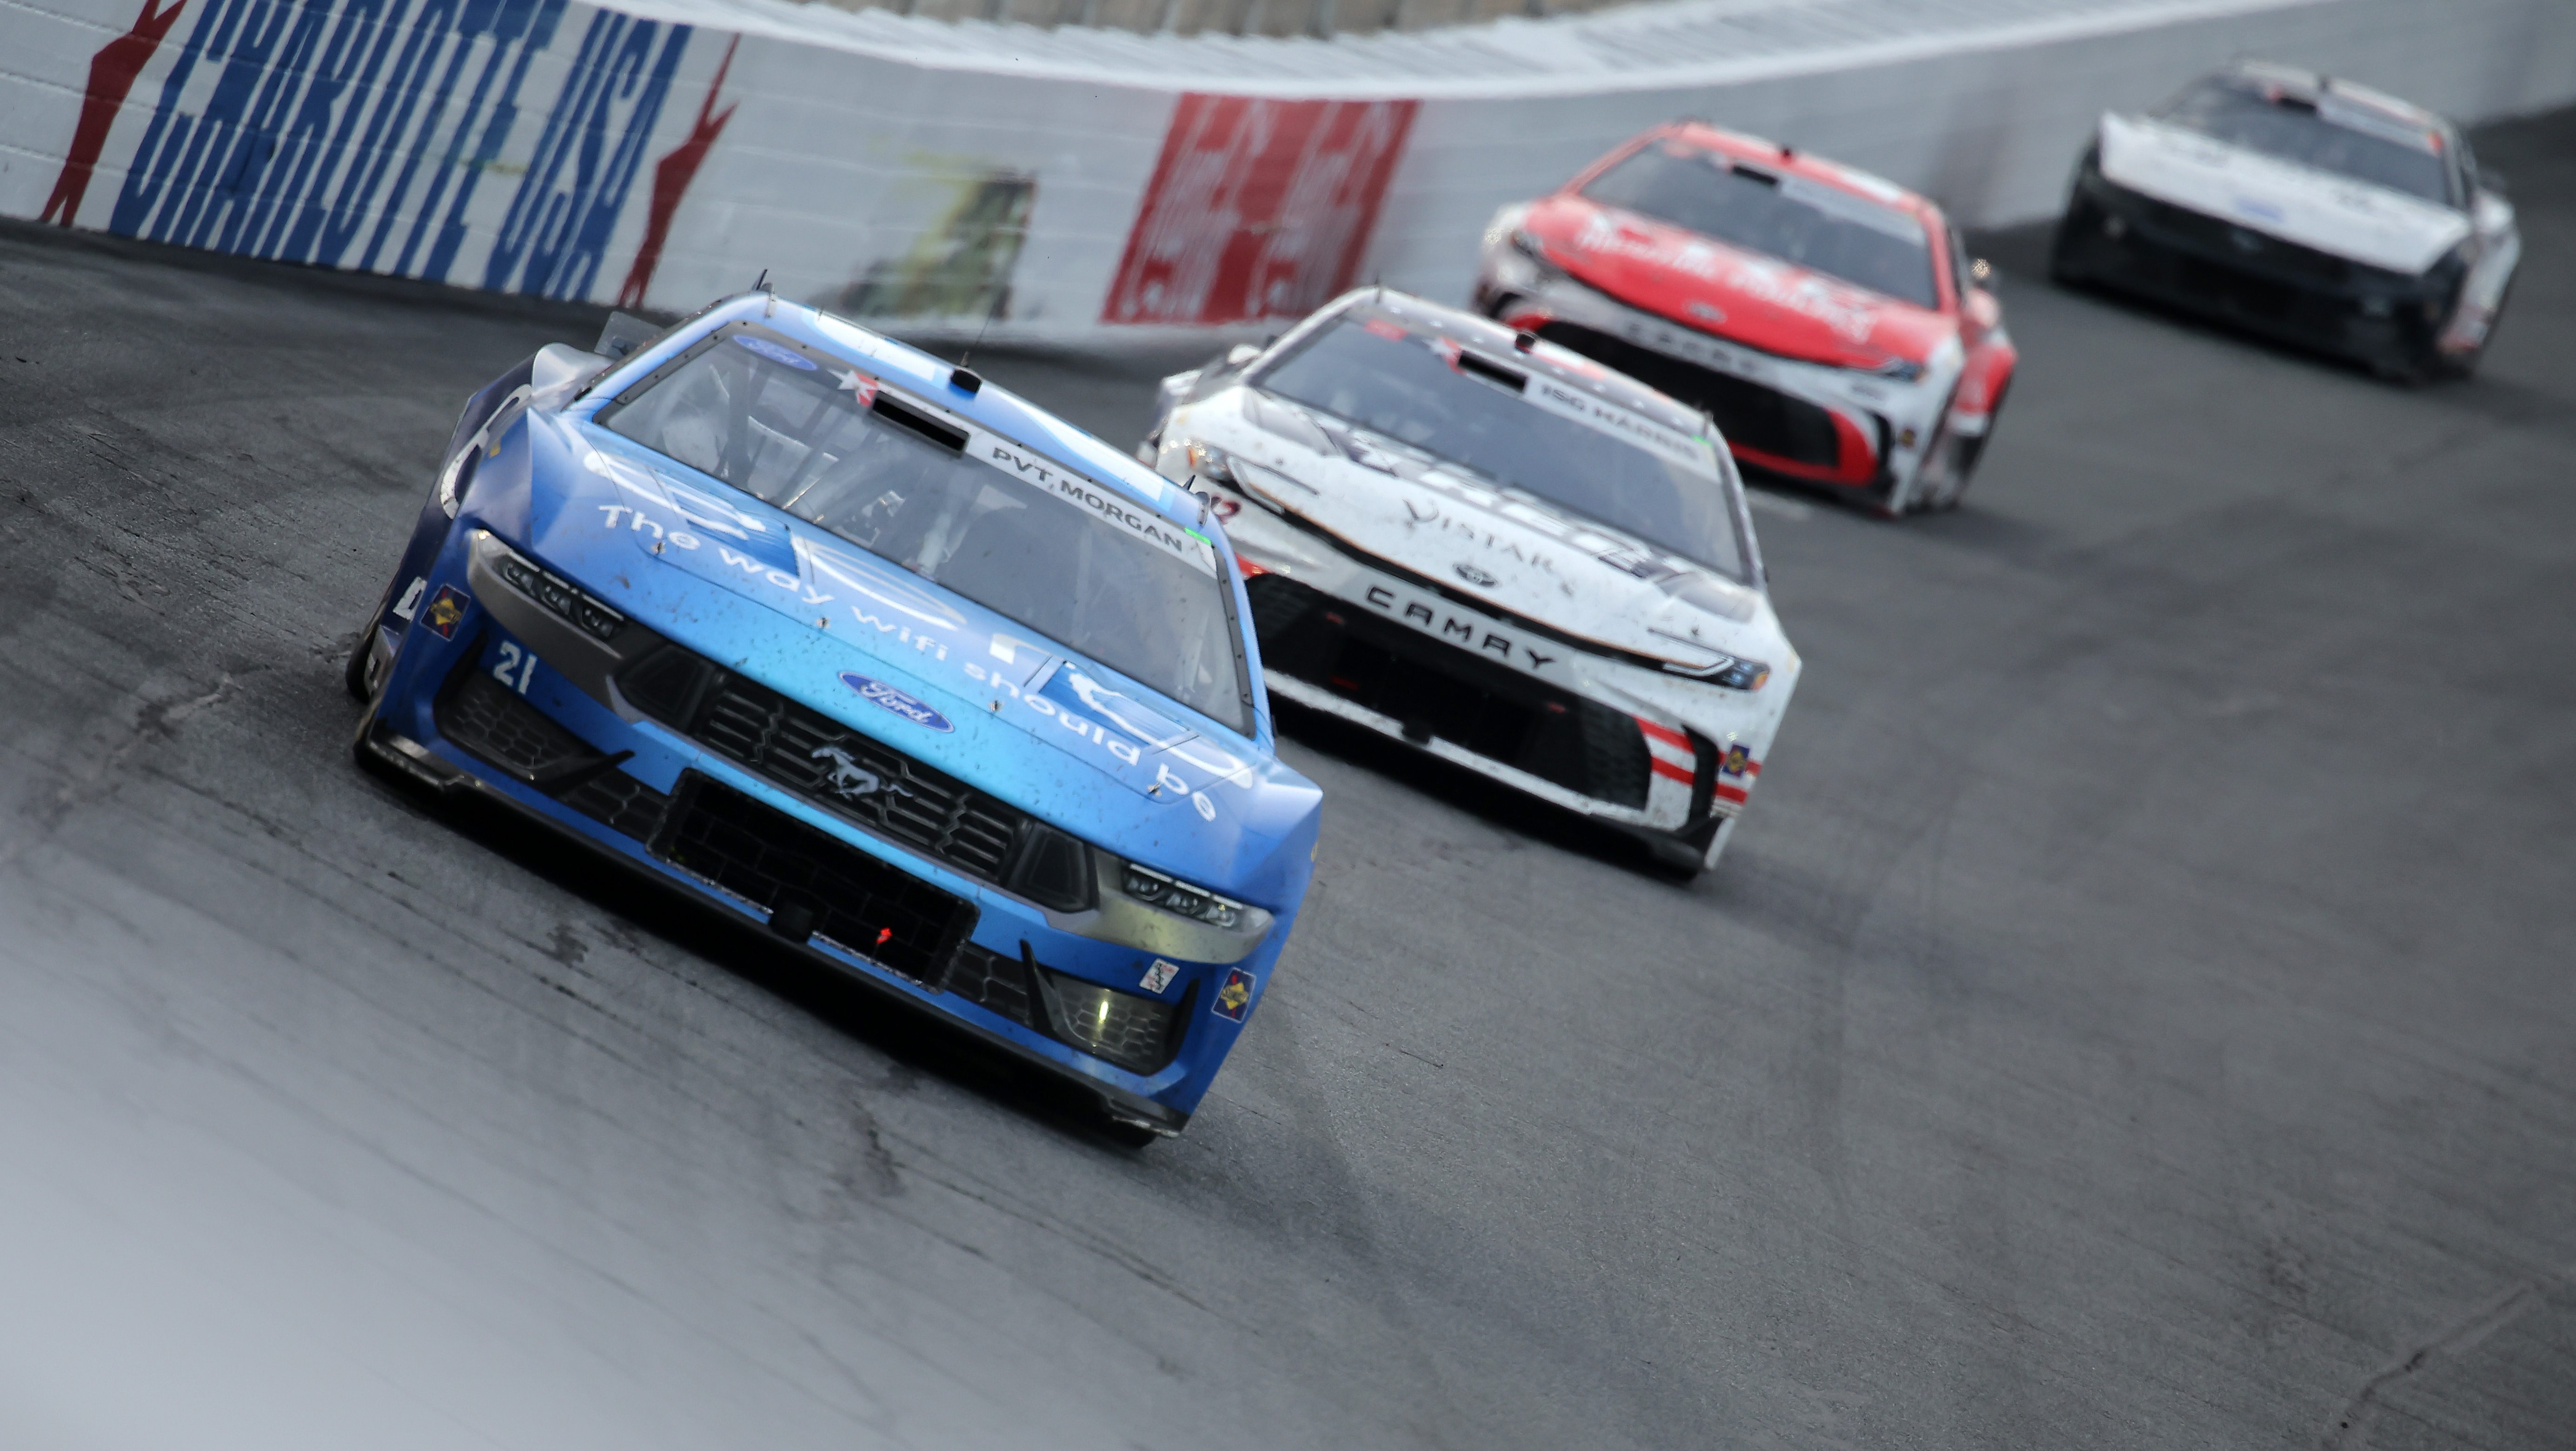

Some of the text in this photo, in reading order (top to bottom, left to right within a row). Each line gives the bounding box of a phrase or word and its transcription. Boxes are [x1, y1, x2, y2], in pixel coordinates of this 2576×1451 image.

[110, 0, 693, 301] CHARLOTTE USA
[1061, 479, 1182, 552] MORGAN
[598, 505, 1216, 822] The way wifi should be
[1368, 587, 1555, 669] CAMRY
[493, 640, 538, 695] 21
[860, 681, 933, 723] Ford
